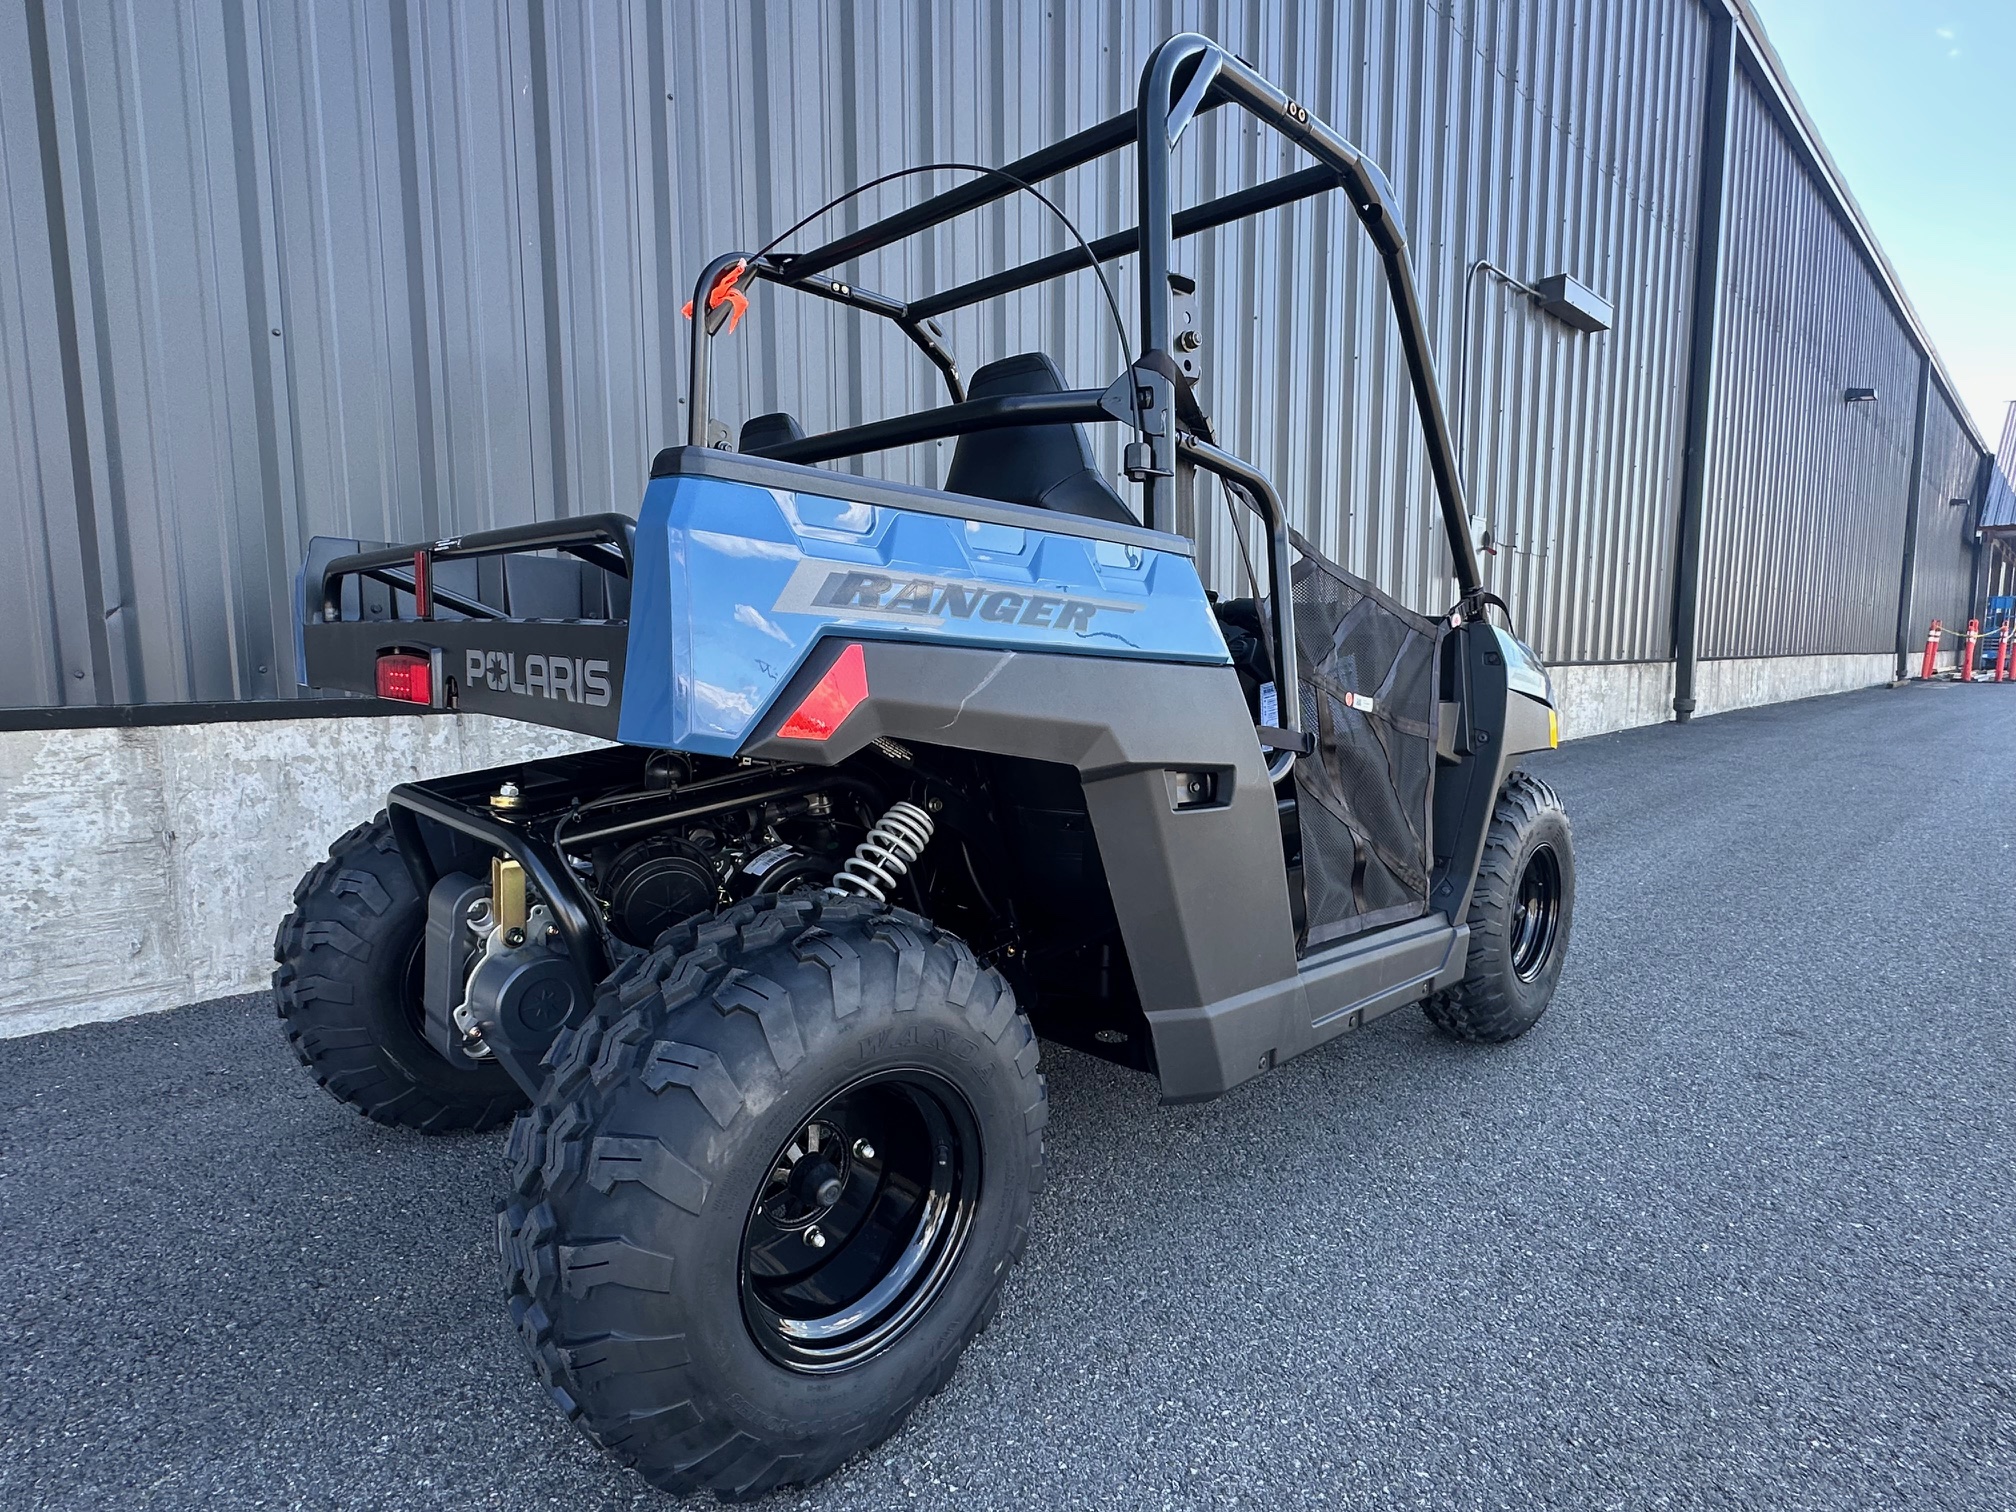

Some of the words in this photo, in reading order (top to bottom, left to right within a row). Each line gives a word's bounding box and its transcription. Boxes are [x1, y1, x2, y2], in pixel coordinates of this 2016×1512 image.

[826, 569, 1098, 633] RANGER
[465, 649, 613, 707] POLARIS
[857, 1024, 997, 1087] WANDA
